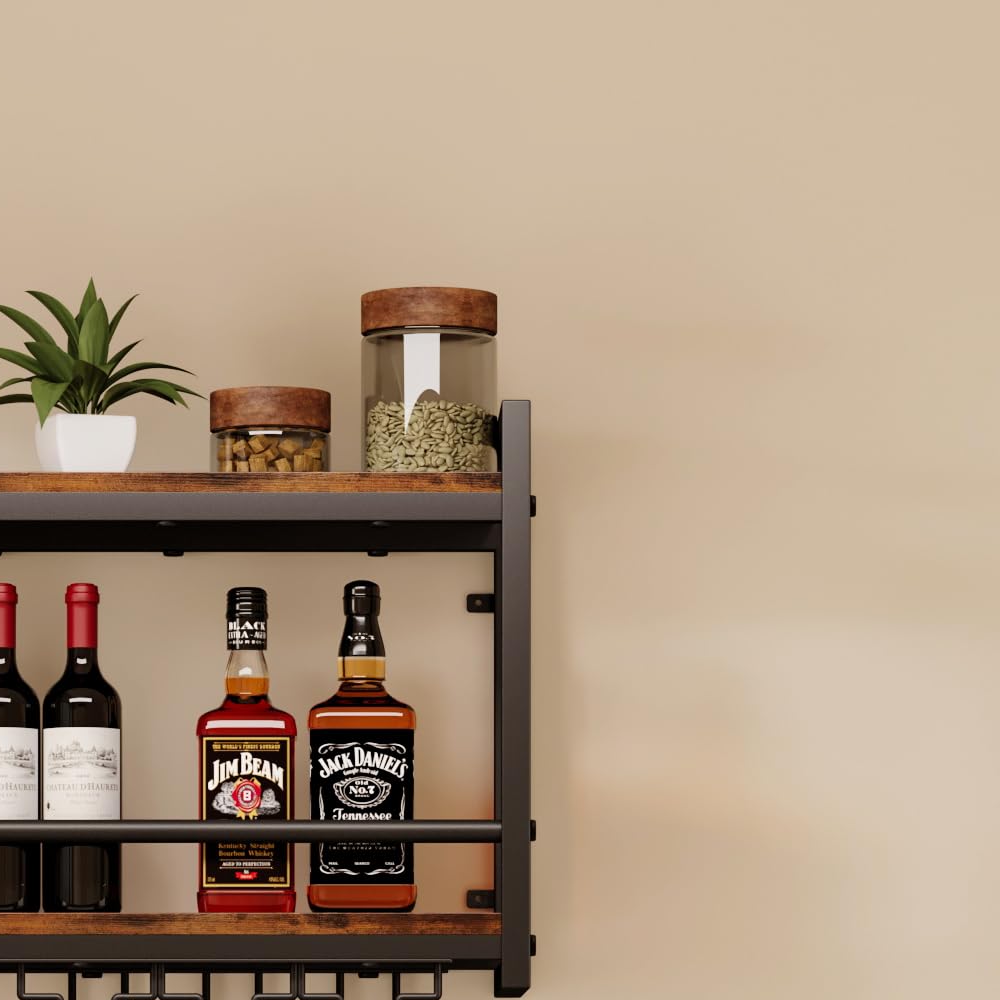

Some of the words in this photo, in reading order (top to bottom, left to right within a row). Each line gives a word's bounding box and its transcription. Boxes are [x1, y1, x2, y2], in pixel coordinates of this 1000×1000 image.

[228, 620, 266, 631] BLACK
[318, 752, 354, 778] JACK
[354, 746, 408, 779] DANIEL'S
[207, 758, 240, 791] JIM
[240, 751, 285, 791] BEAM
[349, 785, 376, 795] No.7
[332, 807, 393, 821] Tennessee
